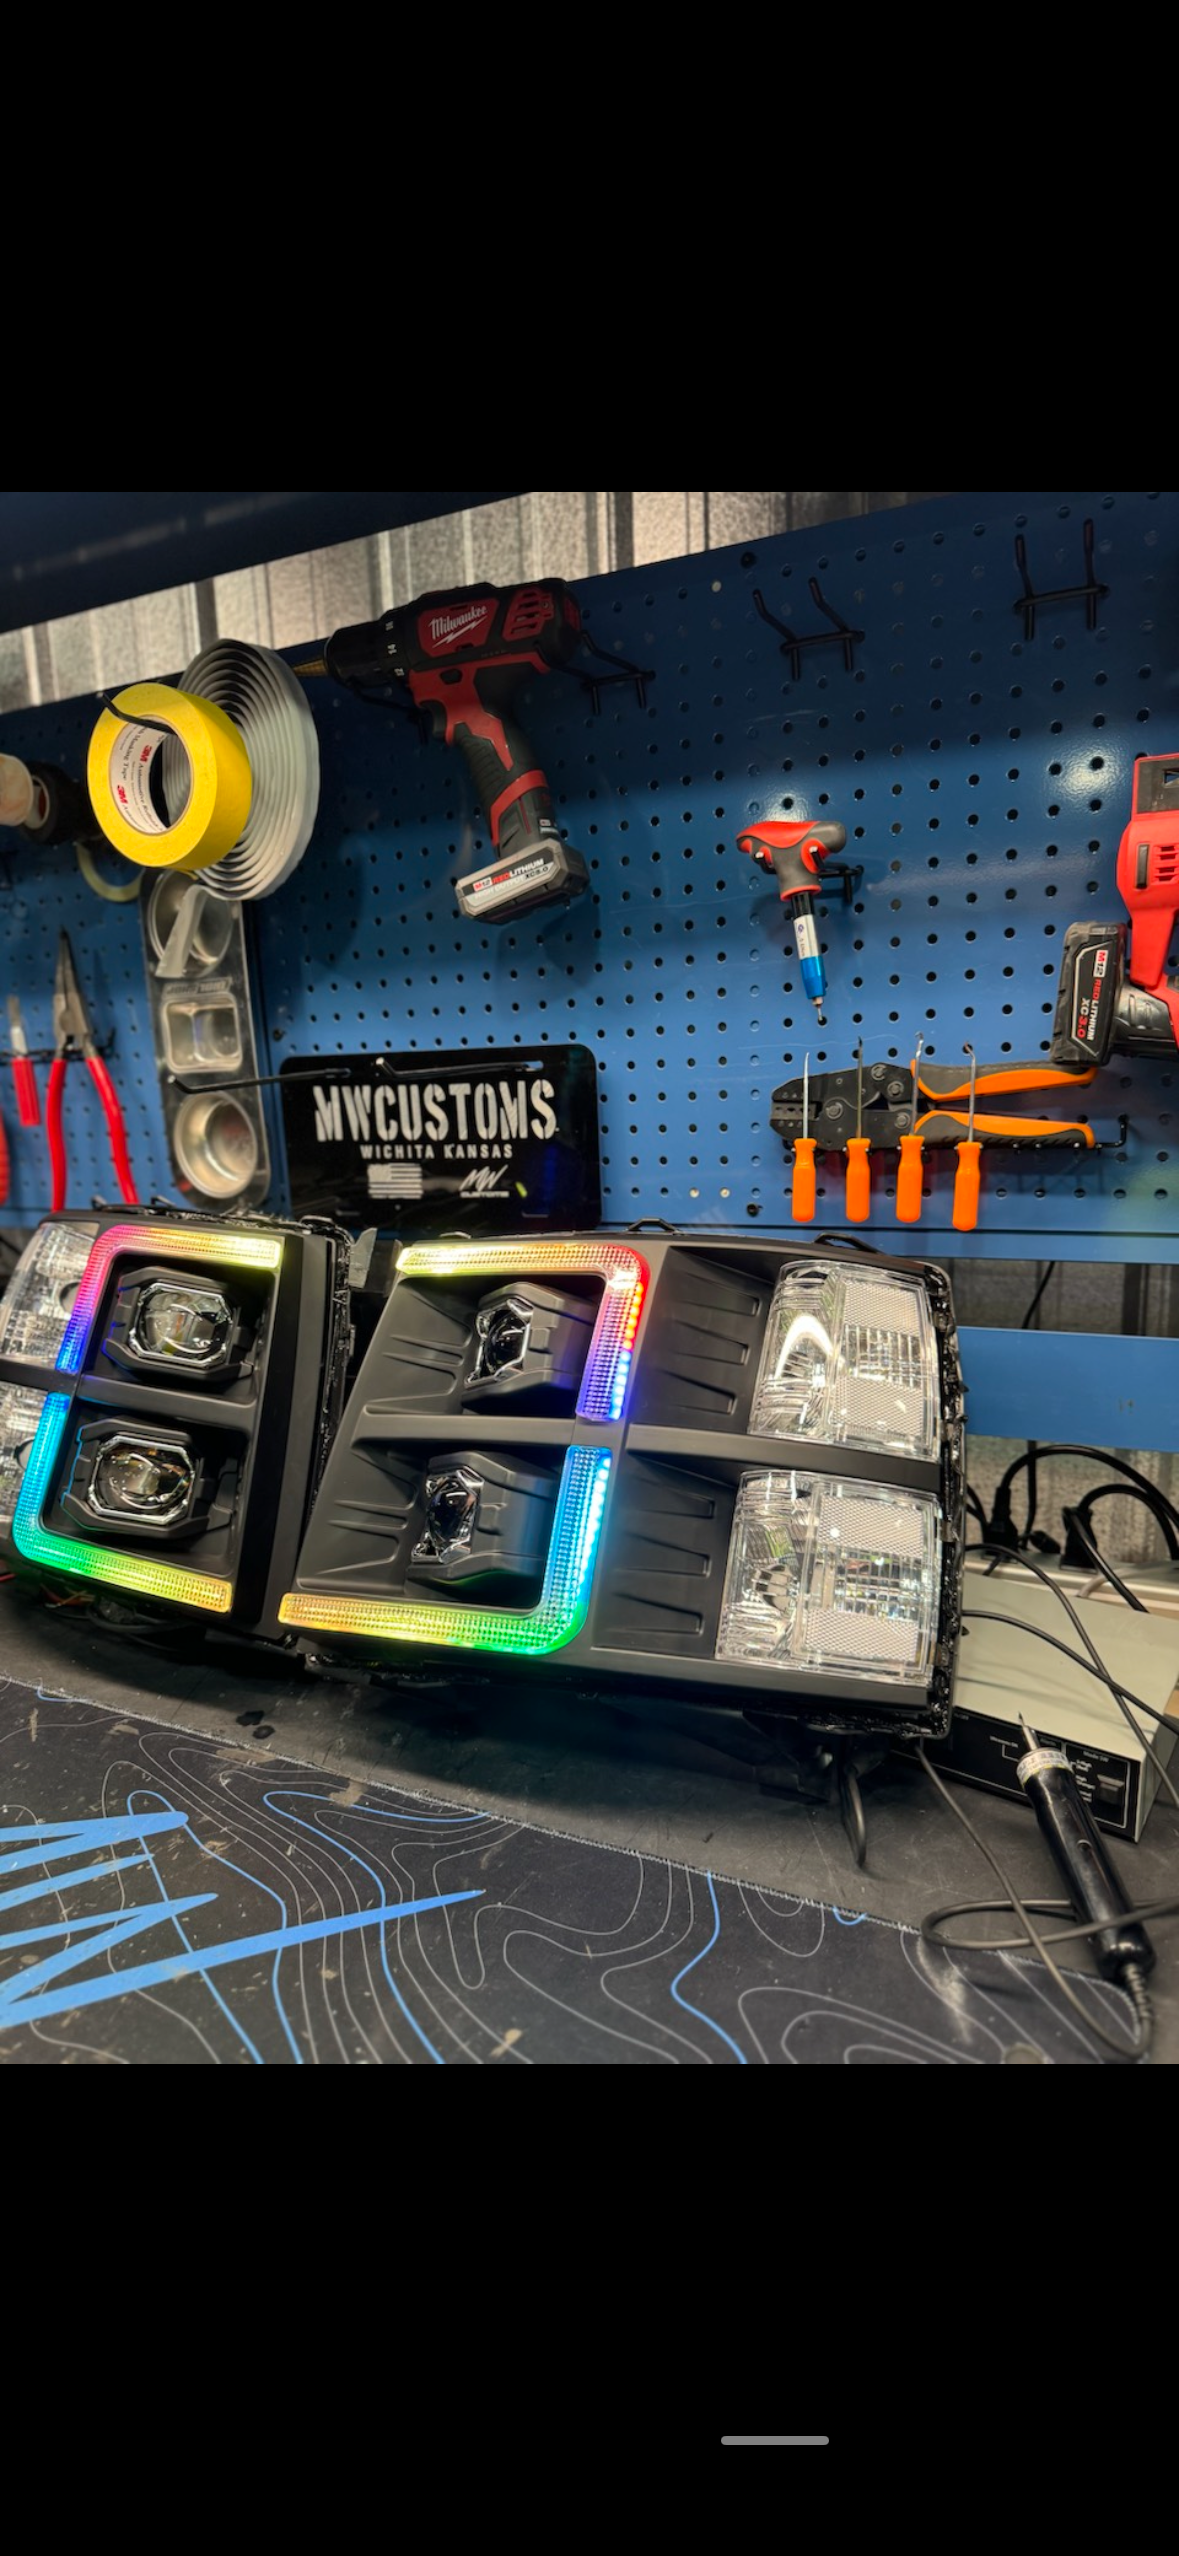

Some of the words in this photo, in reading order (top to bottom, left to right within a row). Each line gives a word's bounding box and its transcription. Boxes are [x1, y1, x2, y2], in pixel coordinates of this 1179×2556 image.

[428, 605, 488, 641] Milwaukee
[140, 745, 152, 763] 3M
[121, 763, 129, 780] Tape
[117, 784, 128, 804] 3M
[1095, 951, 1107, 976] M12
[1087, 978, 1102, 1041] REDLITHIUM
[313, 1079, 557, 1142] MWCUSTOMS
[360, 1144, 434, 1159] WICHITA
[444, 1143, 513, 1159] KANSAS
